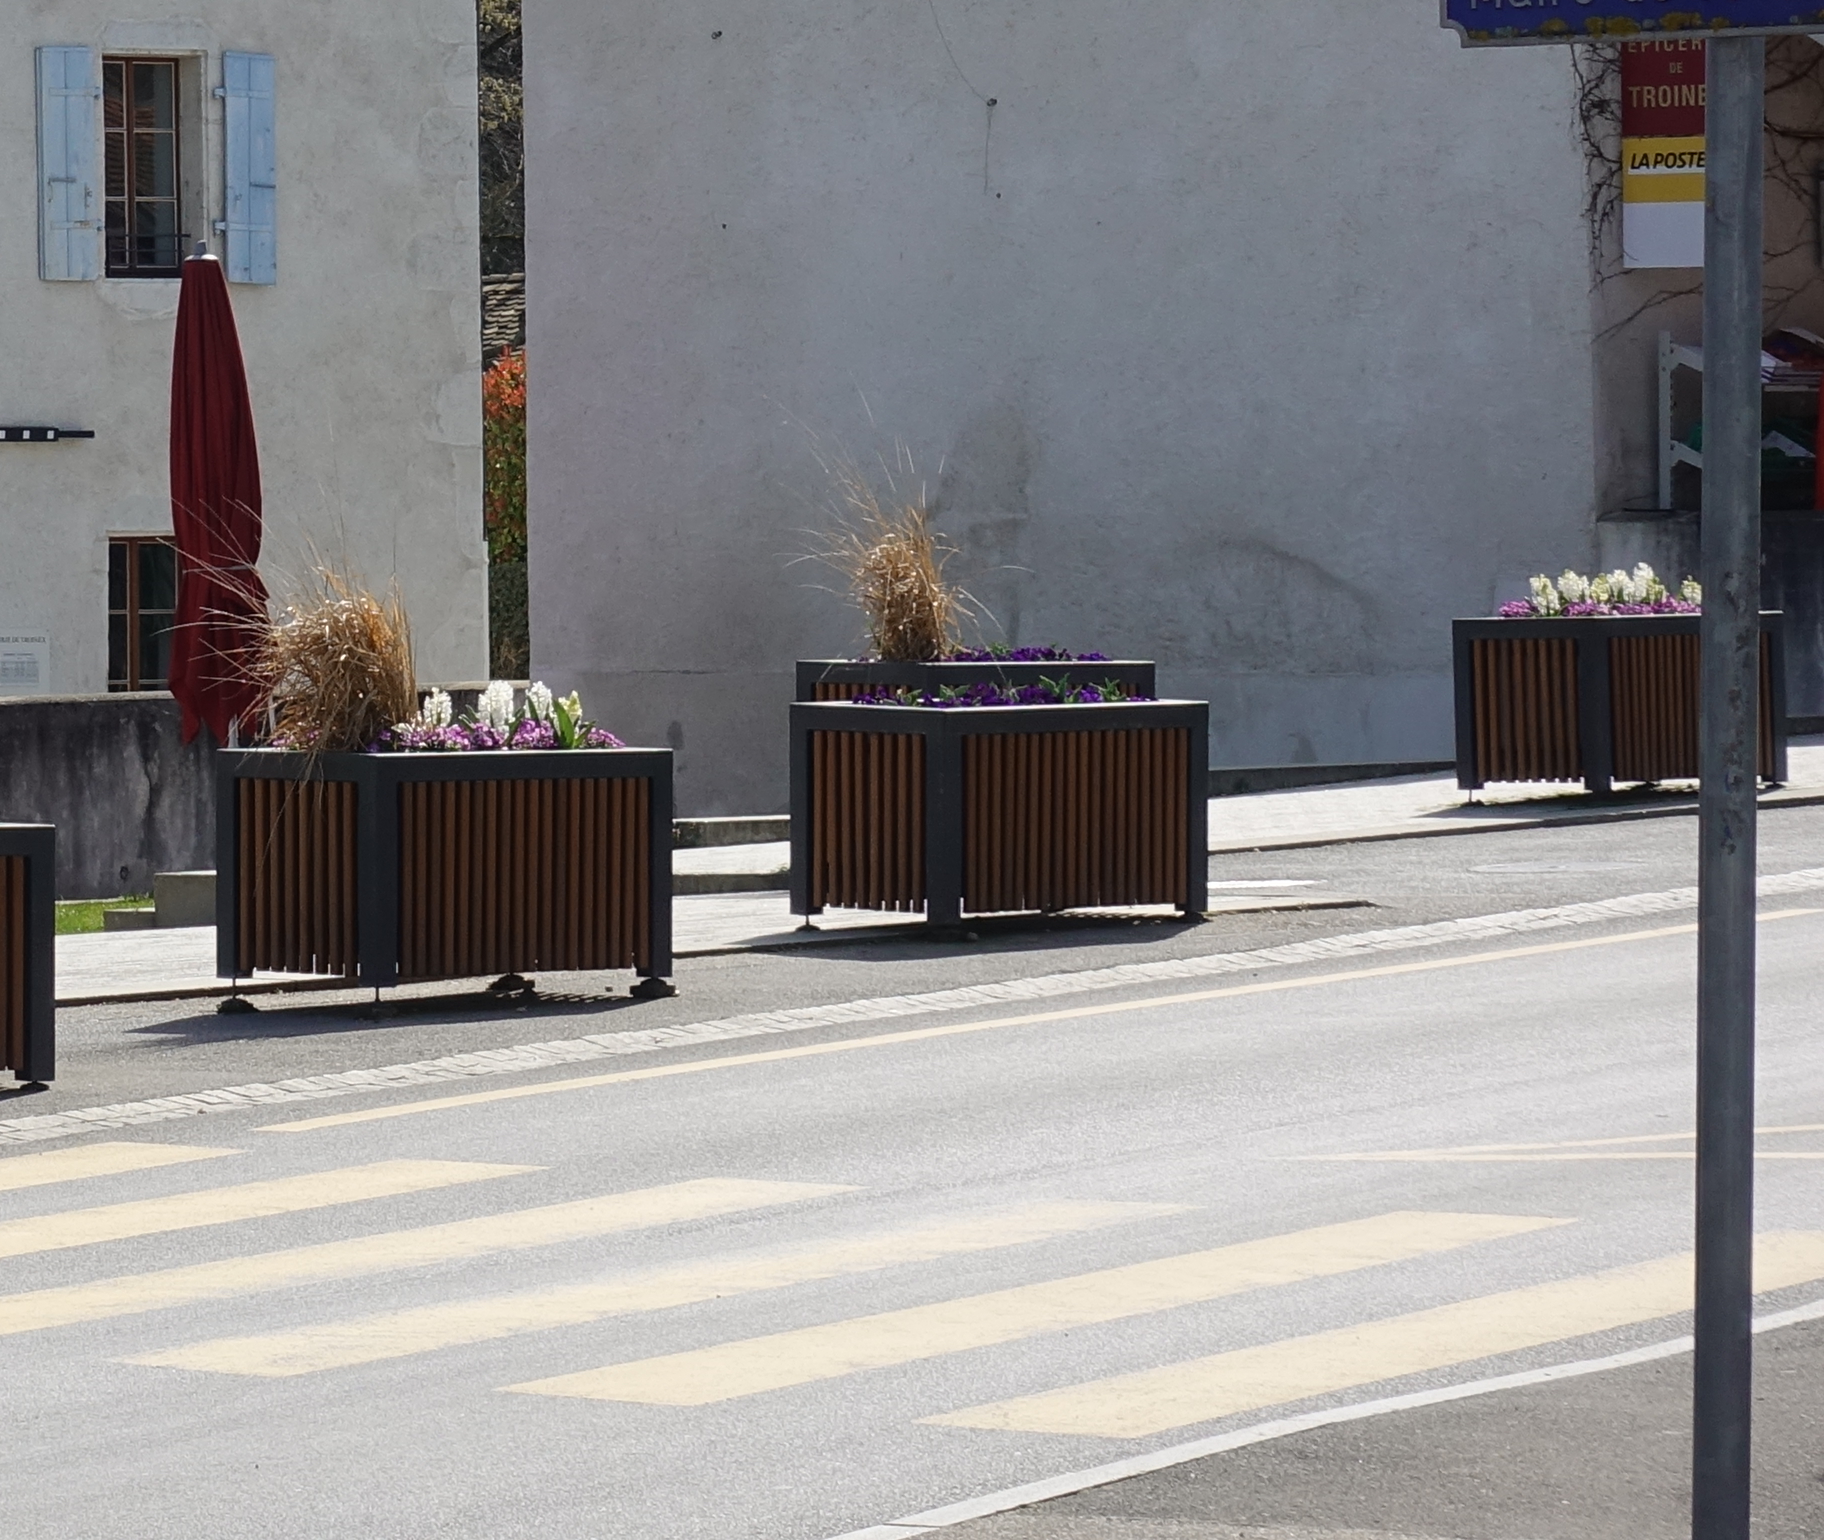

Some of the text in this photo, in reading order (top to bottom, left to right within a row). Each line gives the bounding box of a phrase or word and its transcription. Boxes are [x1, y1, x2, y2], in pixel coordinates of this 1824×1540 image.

[1669, 61, 1683, 74] DE
[1628, 84, 1706, 108] TROINE
[1630, 151, 1706, 170] LA POSTE
